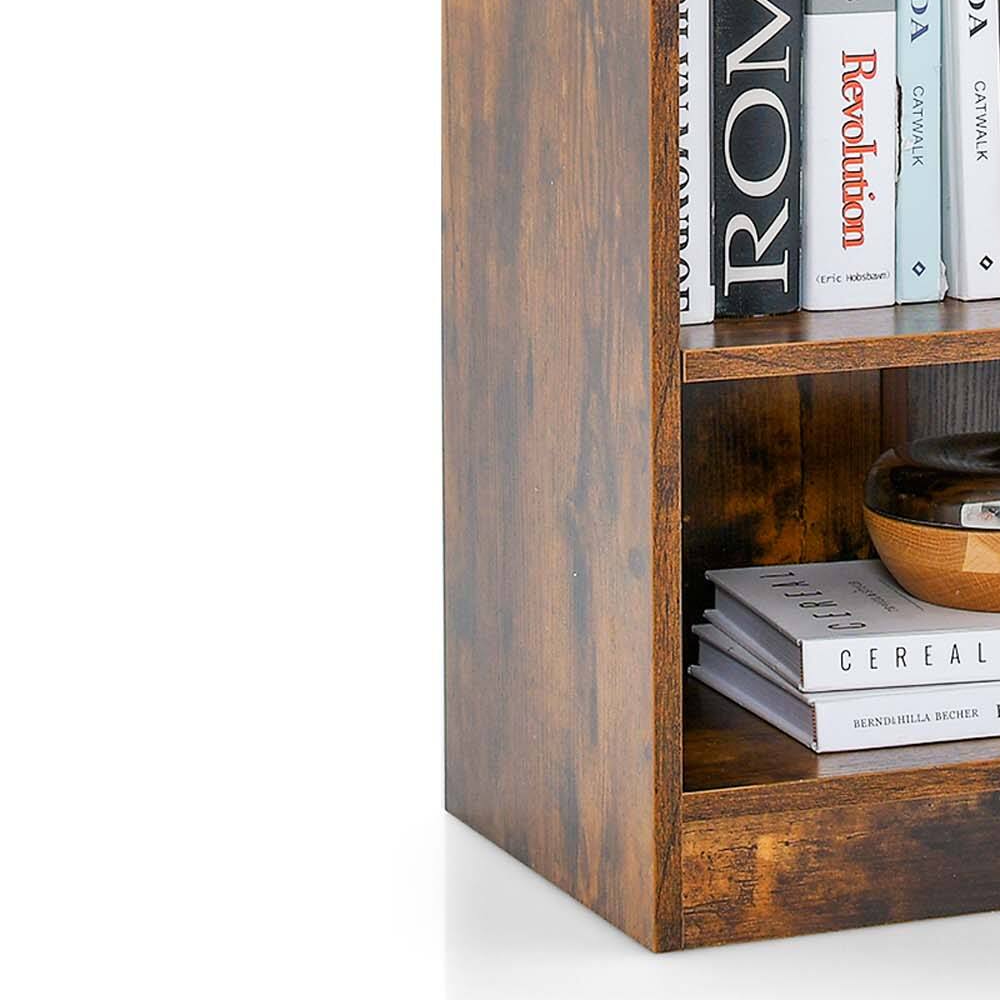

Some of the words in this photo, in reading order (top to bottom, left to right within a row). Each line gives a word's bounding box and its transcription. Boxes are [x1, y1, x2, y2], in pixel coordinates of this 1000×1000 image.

[841, 48, 878, 251] Revolution
[911, 85, 925, 167] CATWALK
[973, 80, 989, 161] CATWALK
[840, 641, 987, 671] CEREAL
[935, 708, 979, 721] BECHER
